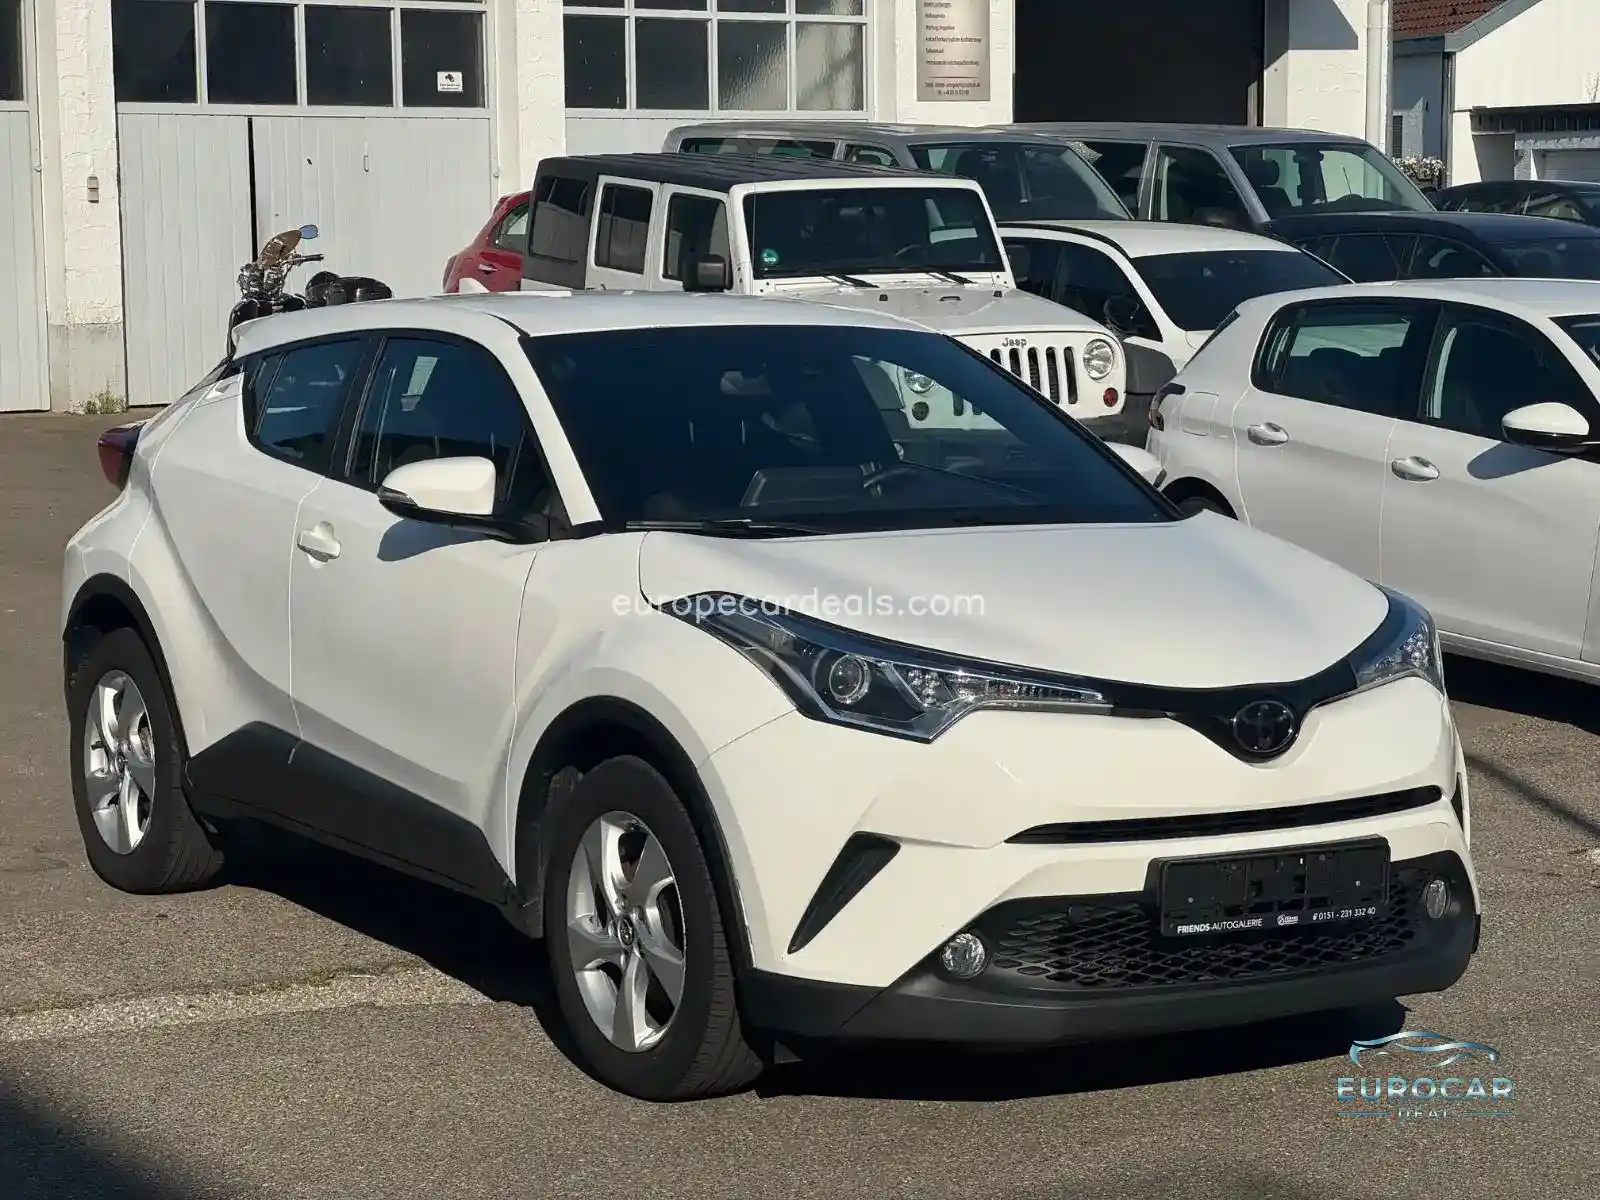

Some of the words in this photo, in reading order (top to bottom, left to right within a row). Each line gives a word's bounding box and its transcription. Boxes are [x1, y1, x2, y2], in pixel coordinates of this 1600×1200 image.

[1002, 337, 1027, 348] Jeep
[1318, 911, 1335, 920] 0151
[1340, 909, 1353, 918] 231
[1354, 907, 1366, 917] 332
[1367, 906, 1376, 915] 40
